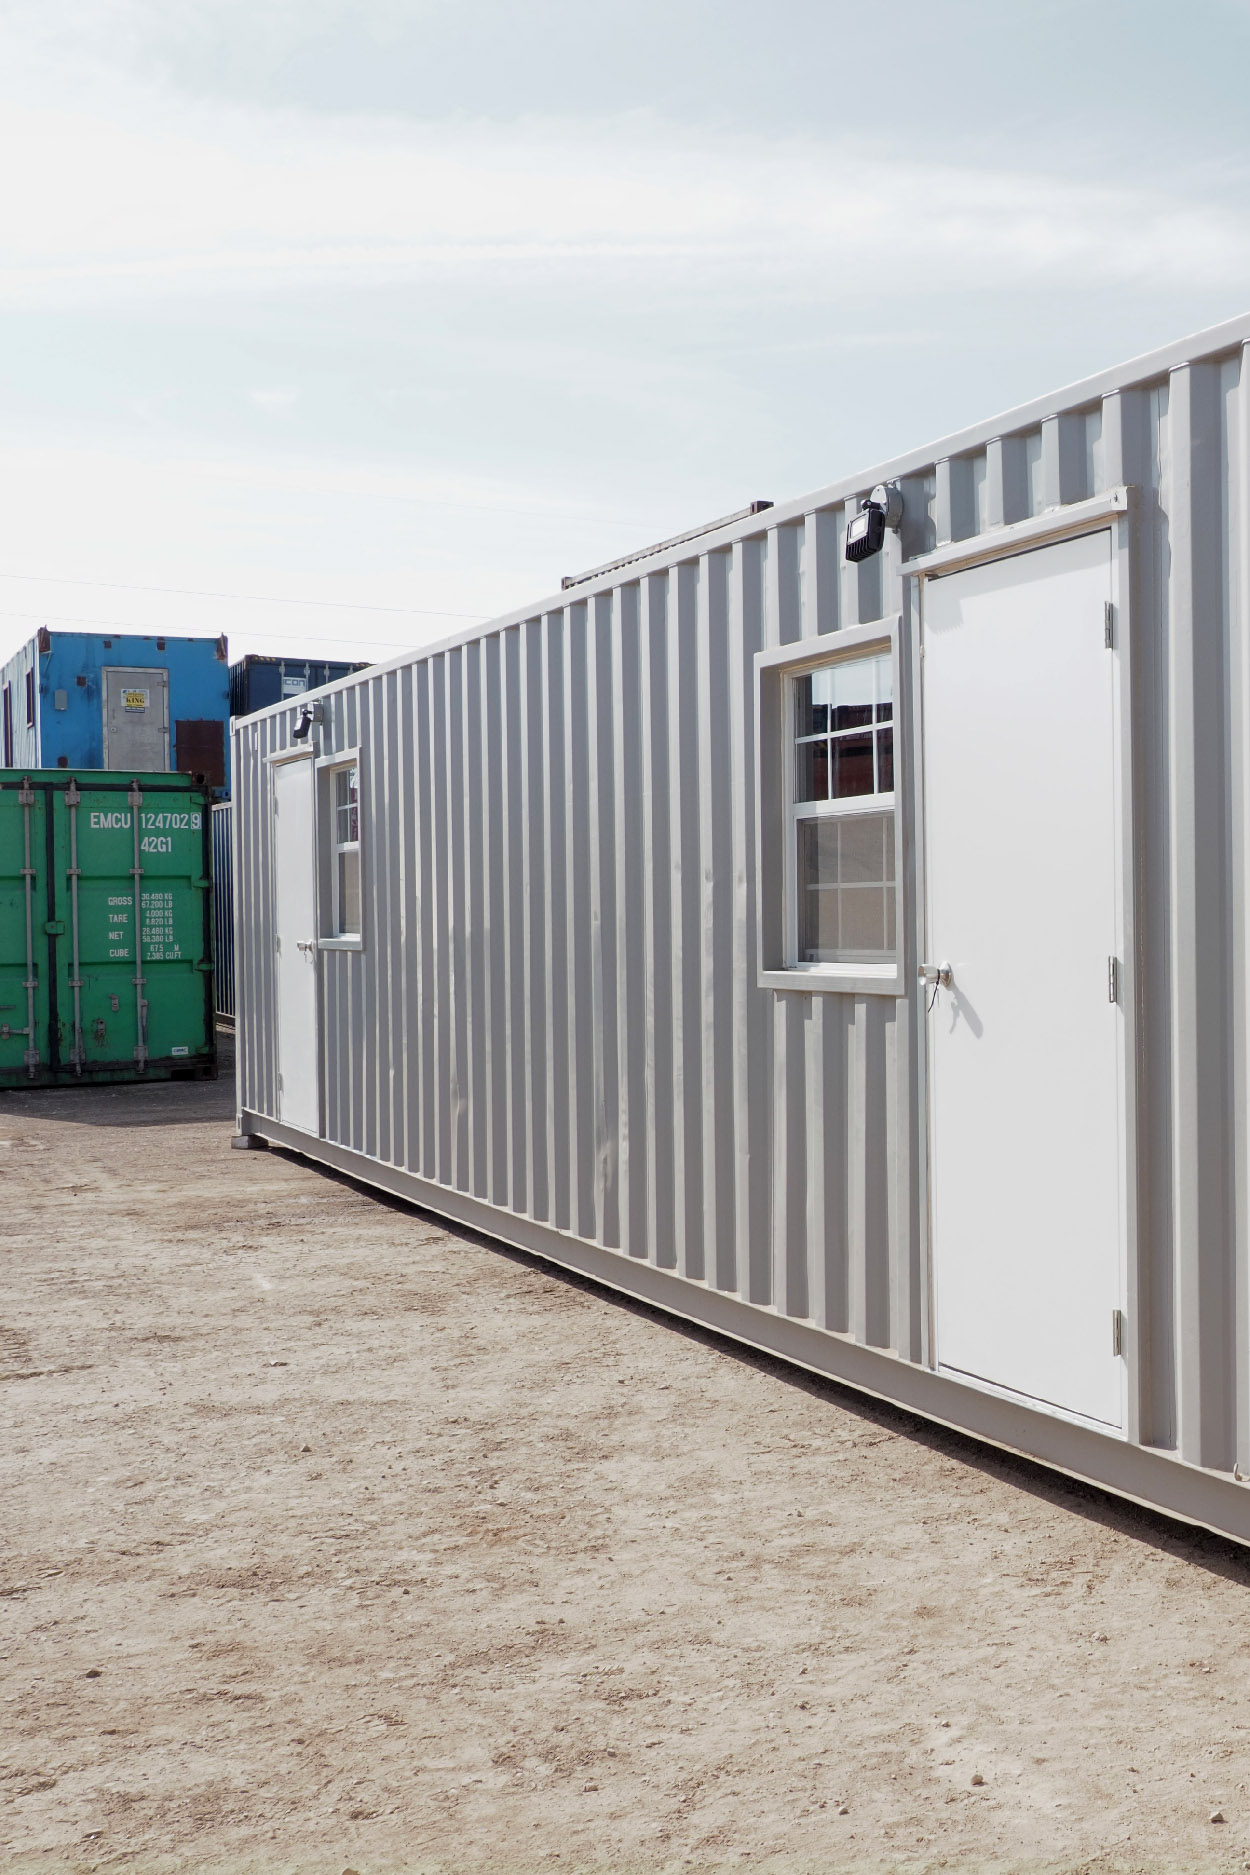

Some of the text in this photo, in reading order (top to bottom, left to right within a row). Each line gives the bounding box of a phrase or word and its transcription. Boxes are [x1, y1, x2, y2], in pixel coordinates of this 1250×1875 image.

[90, 812, 131, 829] EMCU
[140, 813, 189, 829] 124702
[141, 837, 172, 852] 42G1
[108, 897, 133, 906] GROSS
[108, 914, 128, 923] TARE
[108, 931, 124, 940] NET
[165, 927, 173, 935] KG
[109, 949, 129, 957] CUBE
